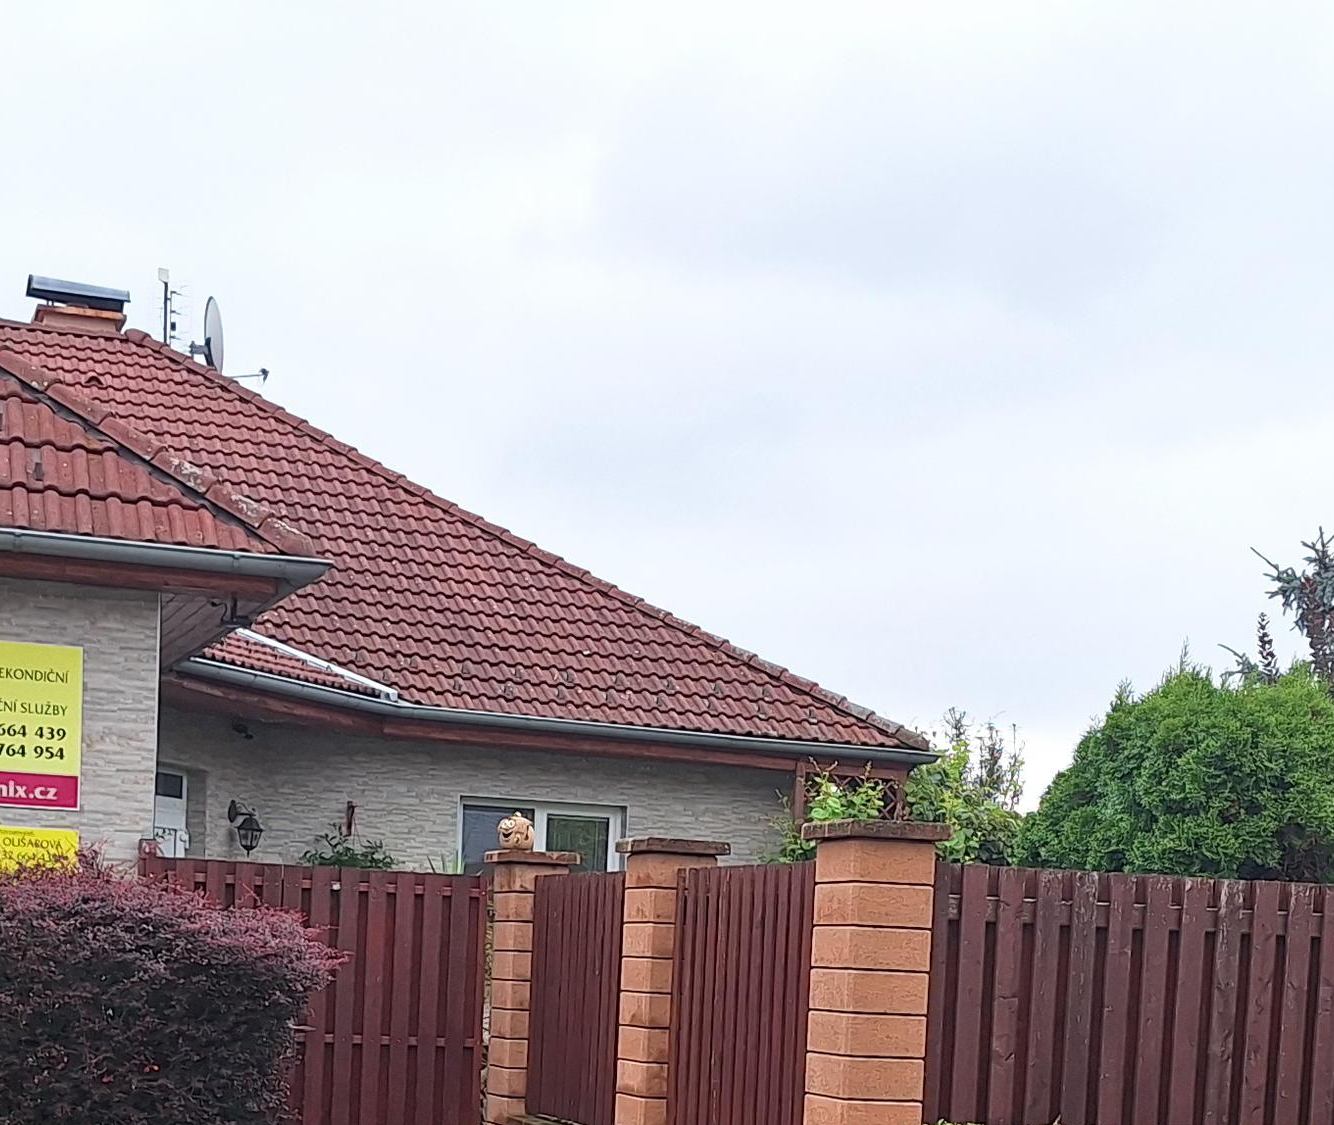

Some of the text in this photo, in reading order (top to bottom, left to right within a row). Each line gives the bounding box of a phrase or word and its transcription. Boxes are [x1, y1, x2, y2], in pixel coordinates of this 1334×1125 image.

[20, 700, 68, 717] SLUŽBY
[34, 726, 67, 742] 439
[33, 745, 66, 761] 954
